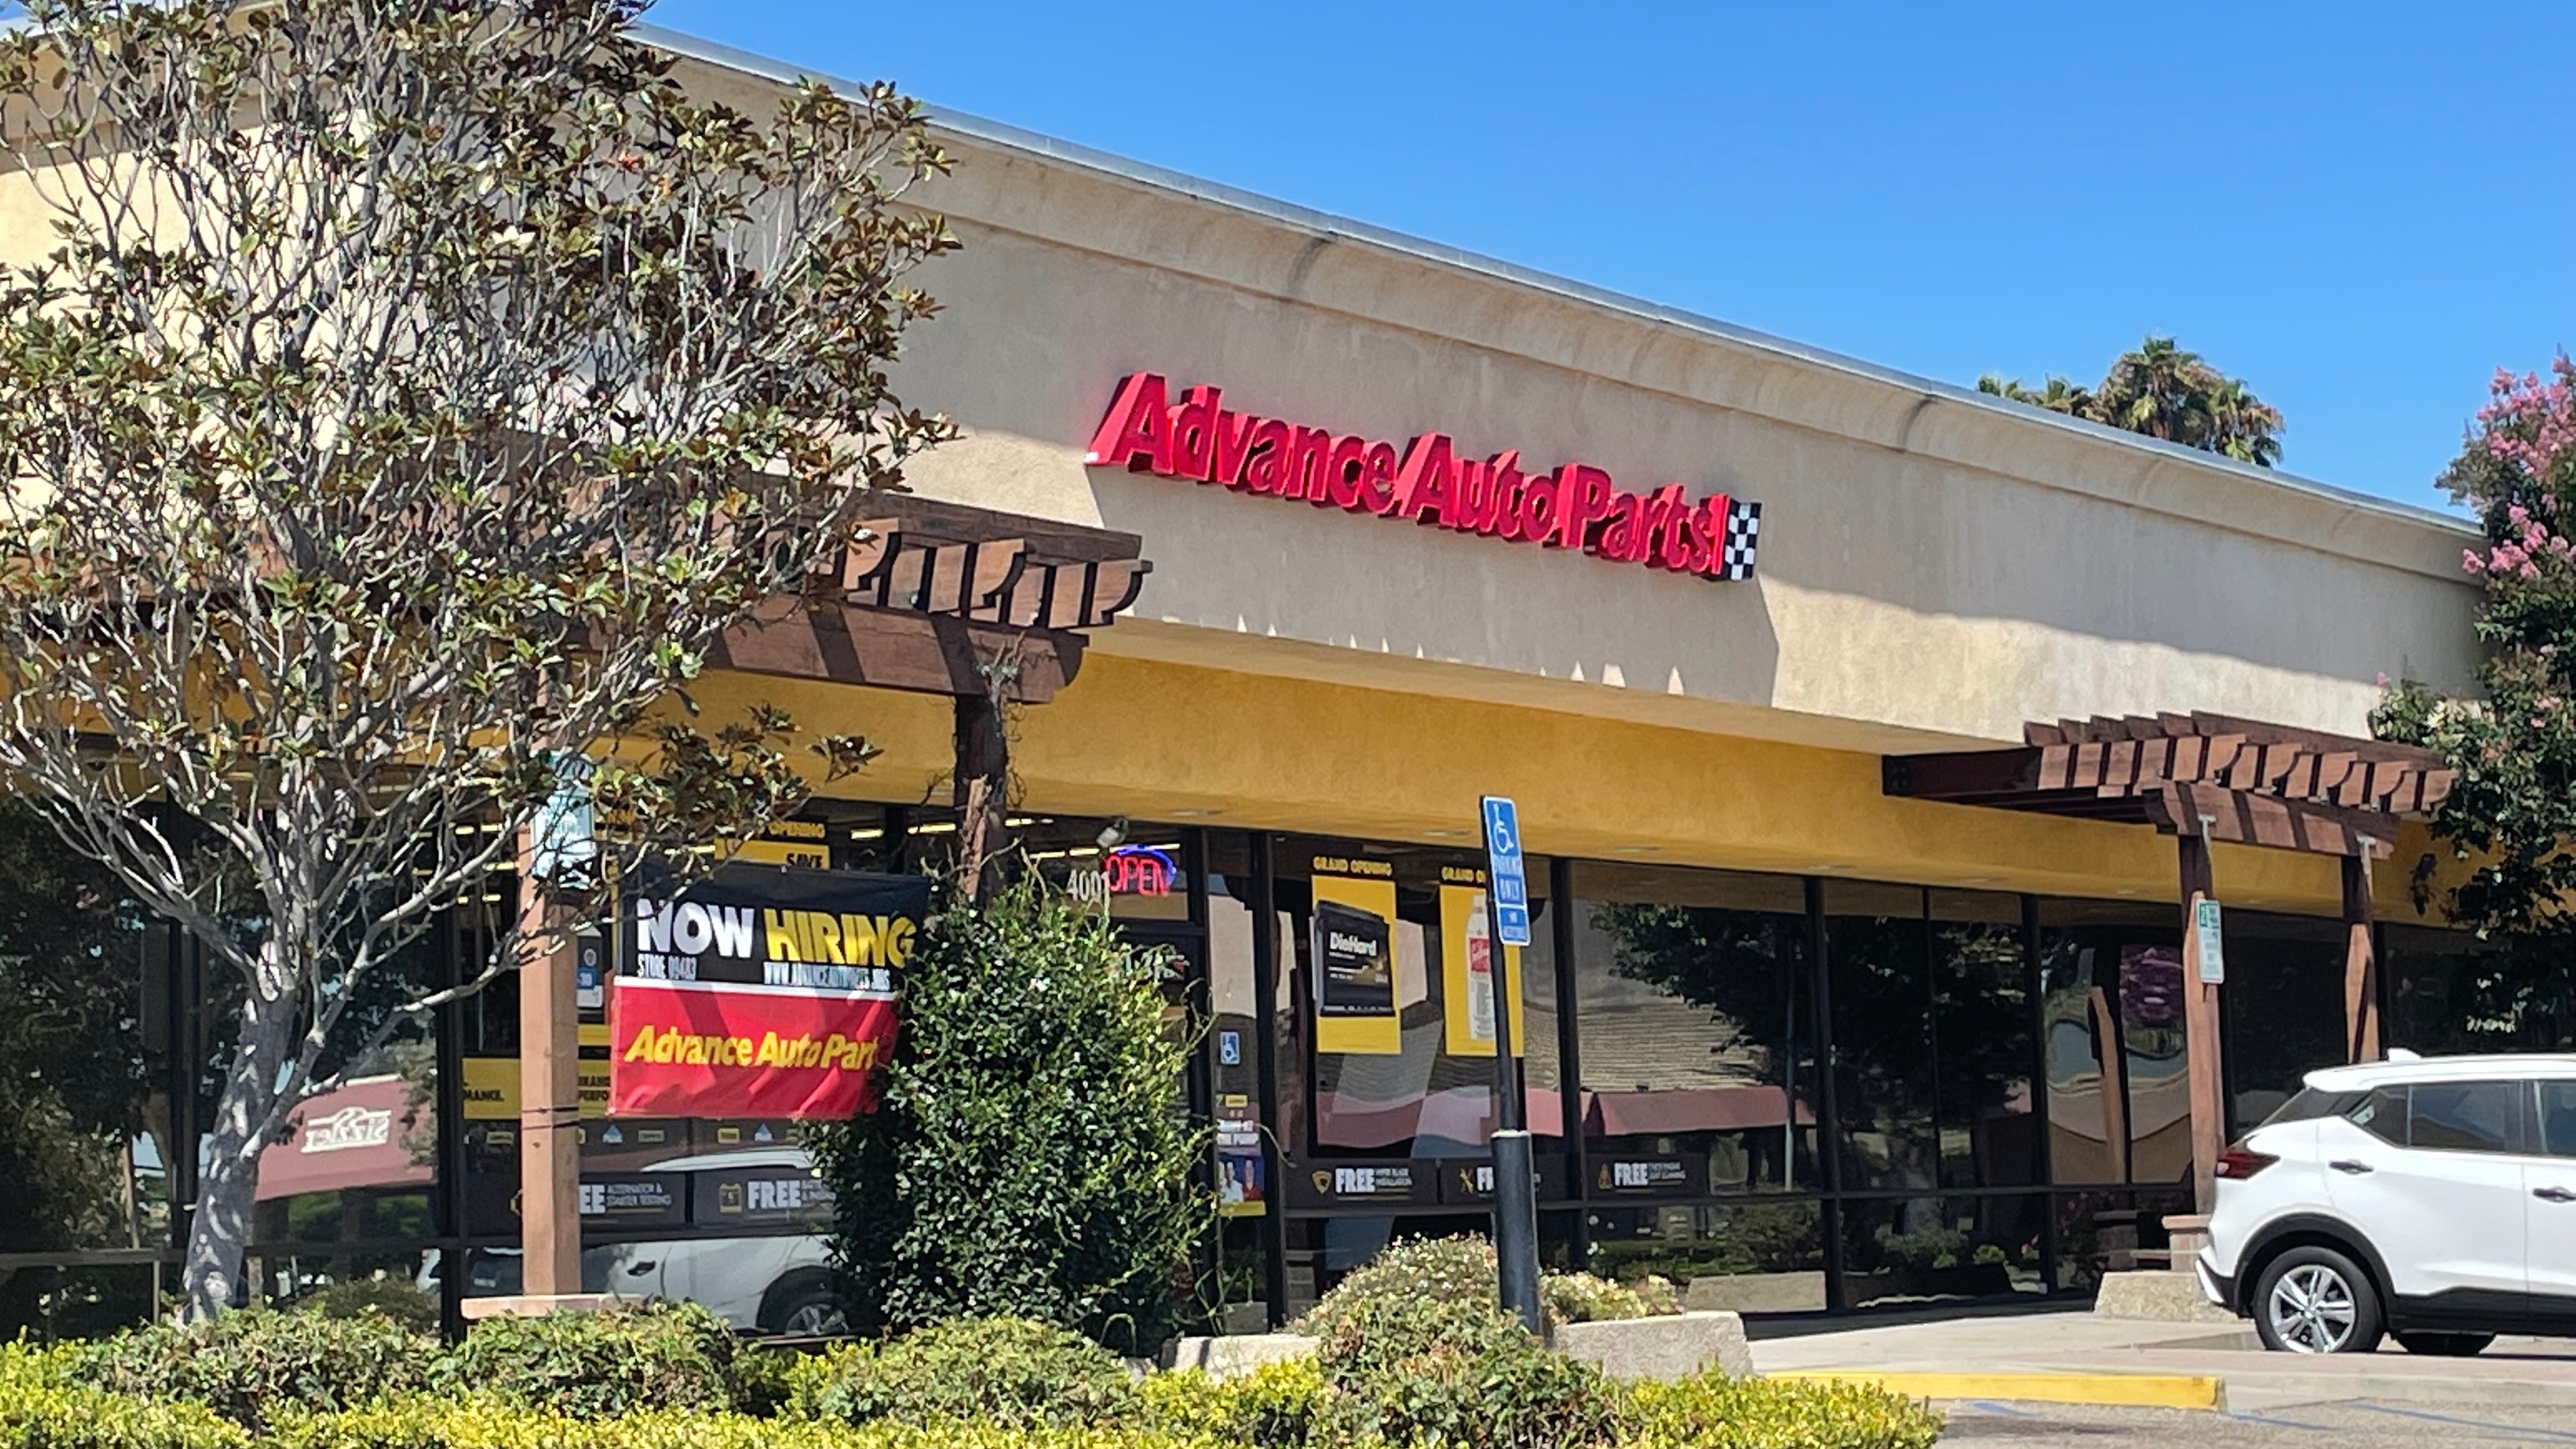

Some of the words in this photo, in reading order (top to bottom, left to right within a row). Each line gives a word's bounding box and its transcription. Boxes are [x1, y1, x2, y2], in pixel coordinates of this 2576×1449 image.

[1085, 370, 1397, 518] Advance
[1392, 431, 1559, 543] Auto
[1543, 463, 1719, 576] Parts
[1066, 869, 1110, 901] 4001
[1105, 855, 1170, 898] OPEN
[637, 898, 755, 958] NOW
[763, 908, 917, 968] HIRING
[1330, 931, 1377, 956] DieHard
[624, 1024, 755, 1066] Advance
[753, 1031, 823, 1068] Auto
[819, 1034, 879, 1071] Part
[1335, 1168, 1375, 1193] FREE
[1476, 1167, 1494, 1191] FR
[1614, 1163, 1648, 1186] FREE
[579, 1184, 606, 1214] EE
[747, 1179, 802, 1209] FREE
